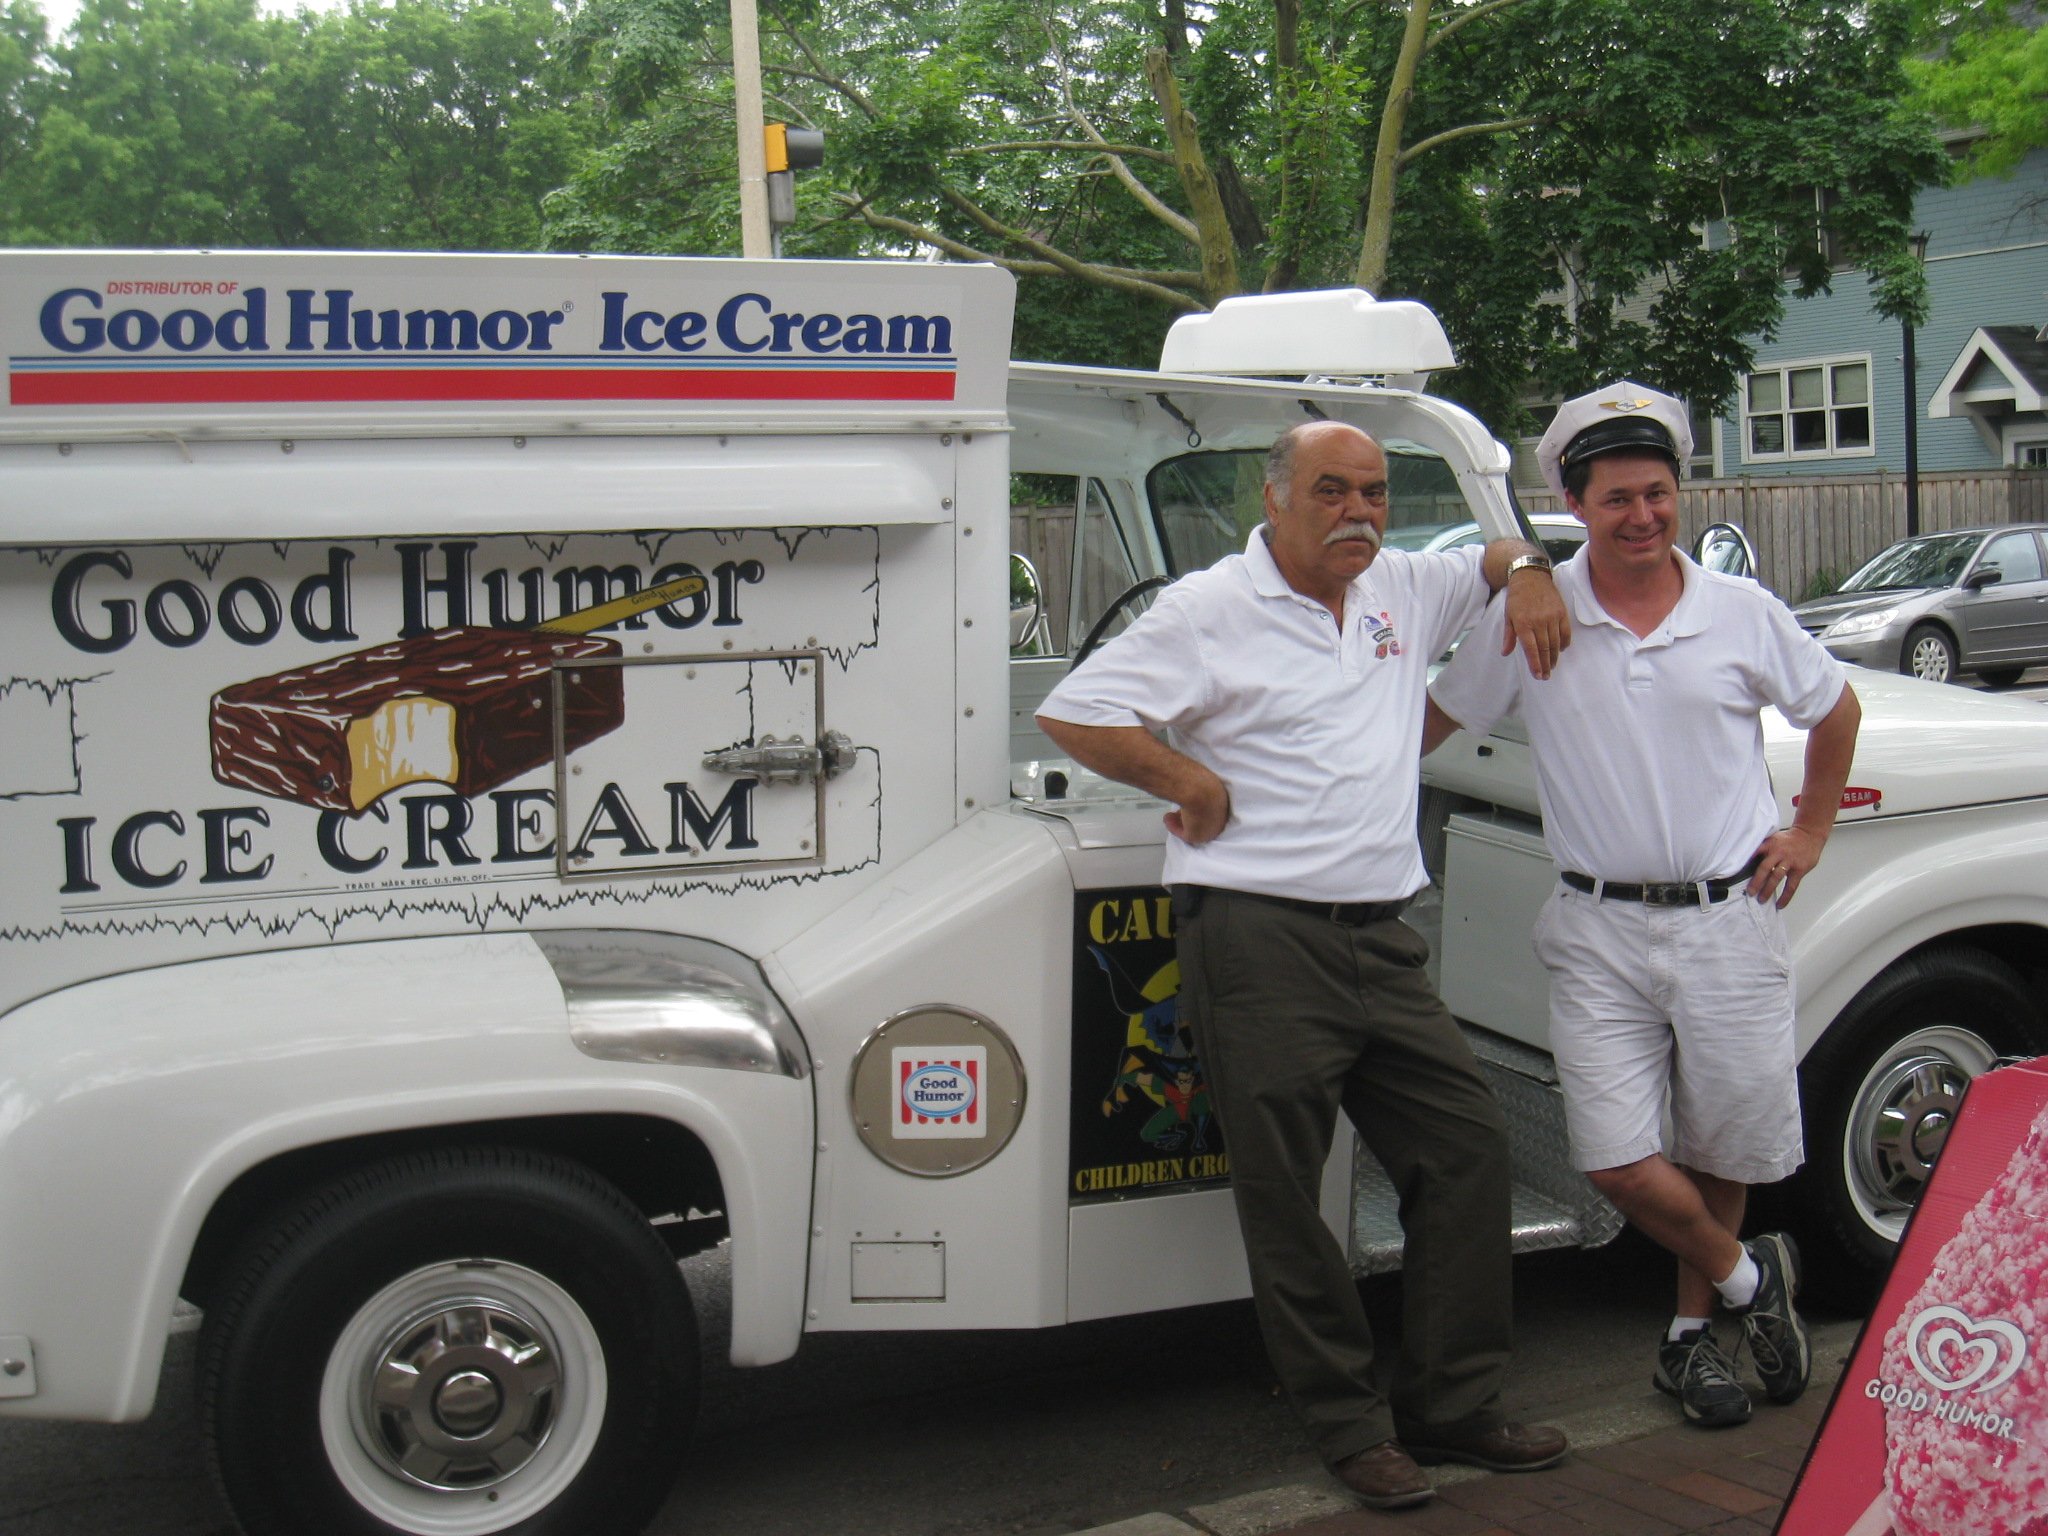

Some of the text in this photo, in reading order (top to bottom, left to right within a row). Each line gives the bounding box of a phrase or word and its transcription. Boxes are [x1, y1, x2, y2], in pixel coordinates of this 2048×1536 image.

[107, 282, 239, 295] DISTRIBUTOR OF
[40, 287, 270, 353] Good
[598, 292, 707, 352] Ice
[716, 292, 952, 353] Cream
[51, 541, 765, 653] Good Humor
[57, 779, 759, 893] ICE CREAM
[345, 882, 375, 890] TRADE
[381, 880, 405, 888] MARK
[914, 1090, 964, 1102] Humor
[920, 1077, 958, 1089] Good
[1075, 1158, 1184, 1192] CHILDREN
[1865, 1379, 2014, 1437] GOOD HUMOR
